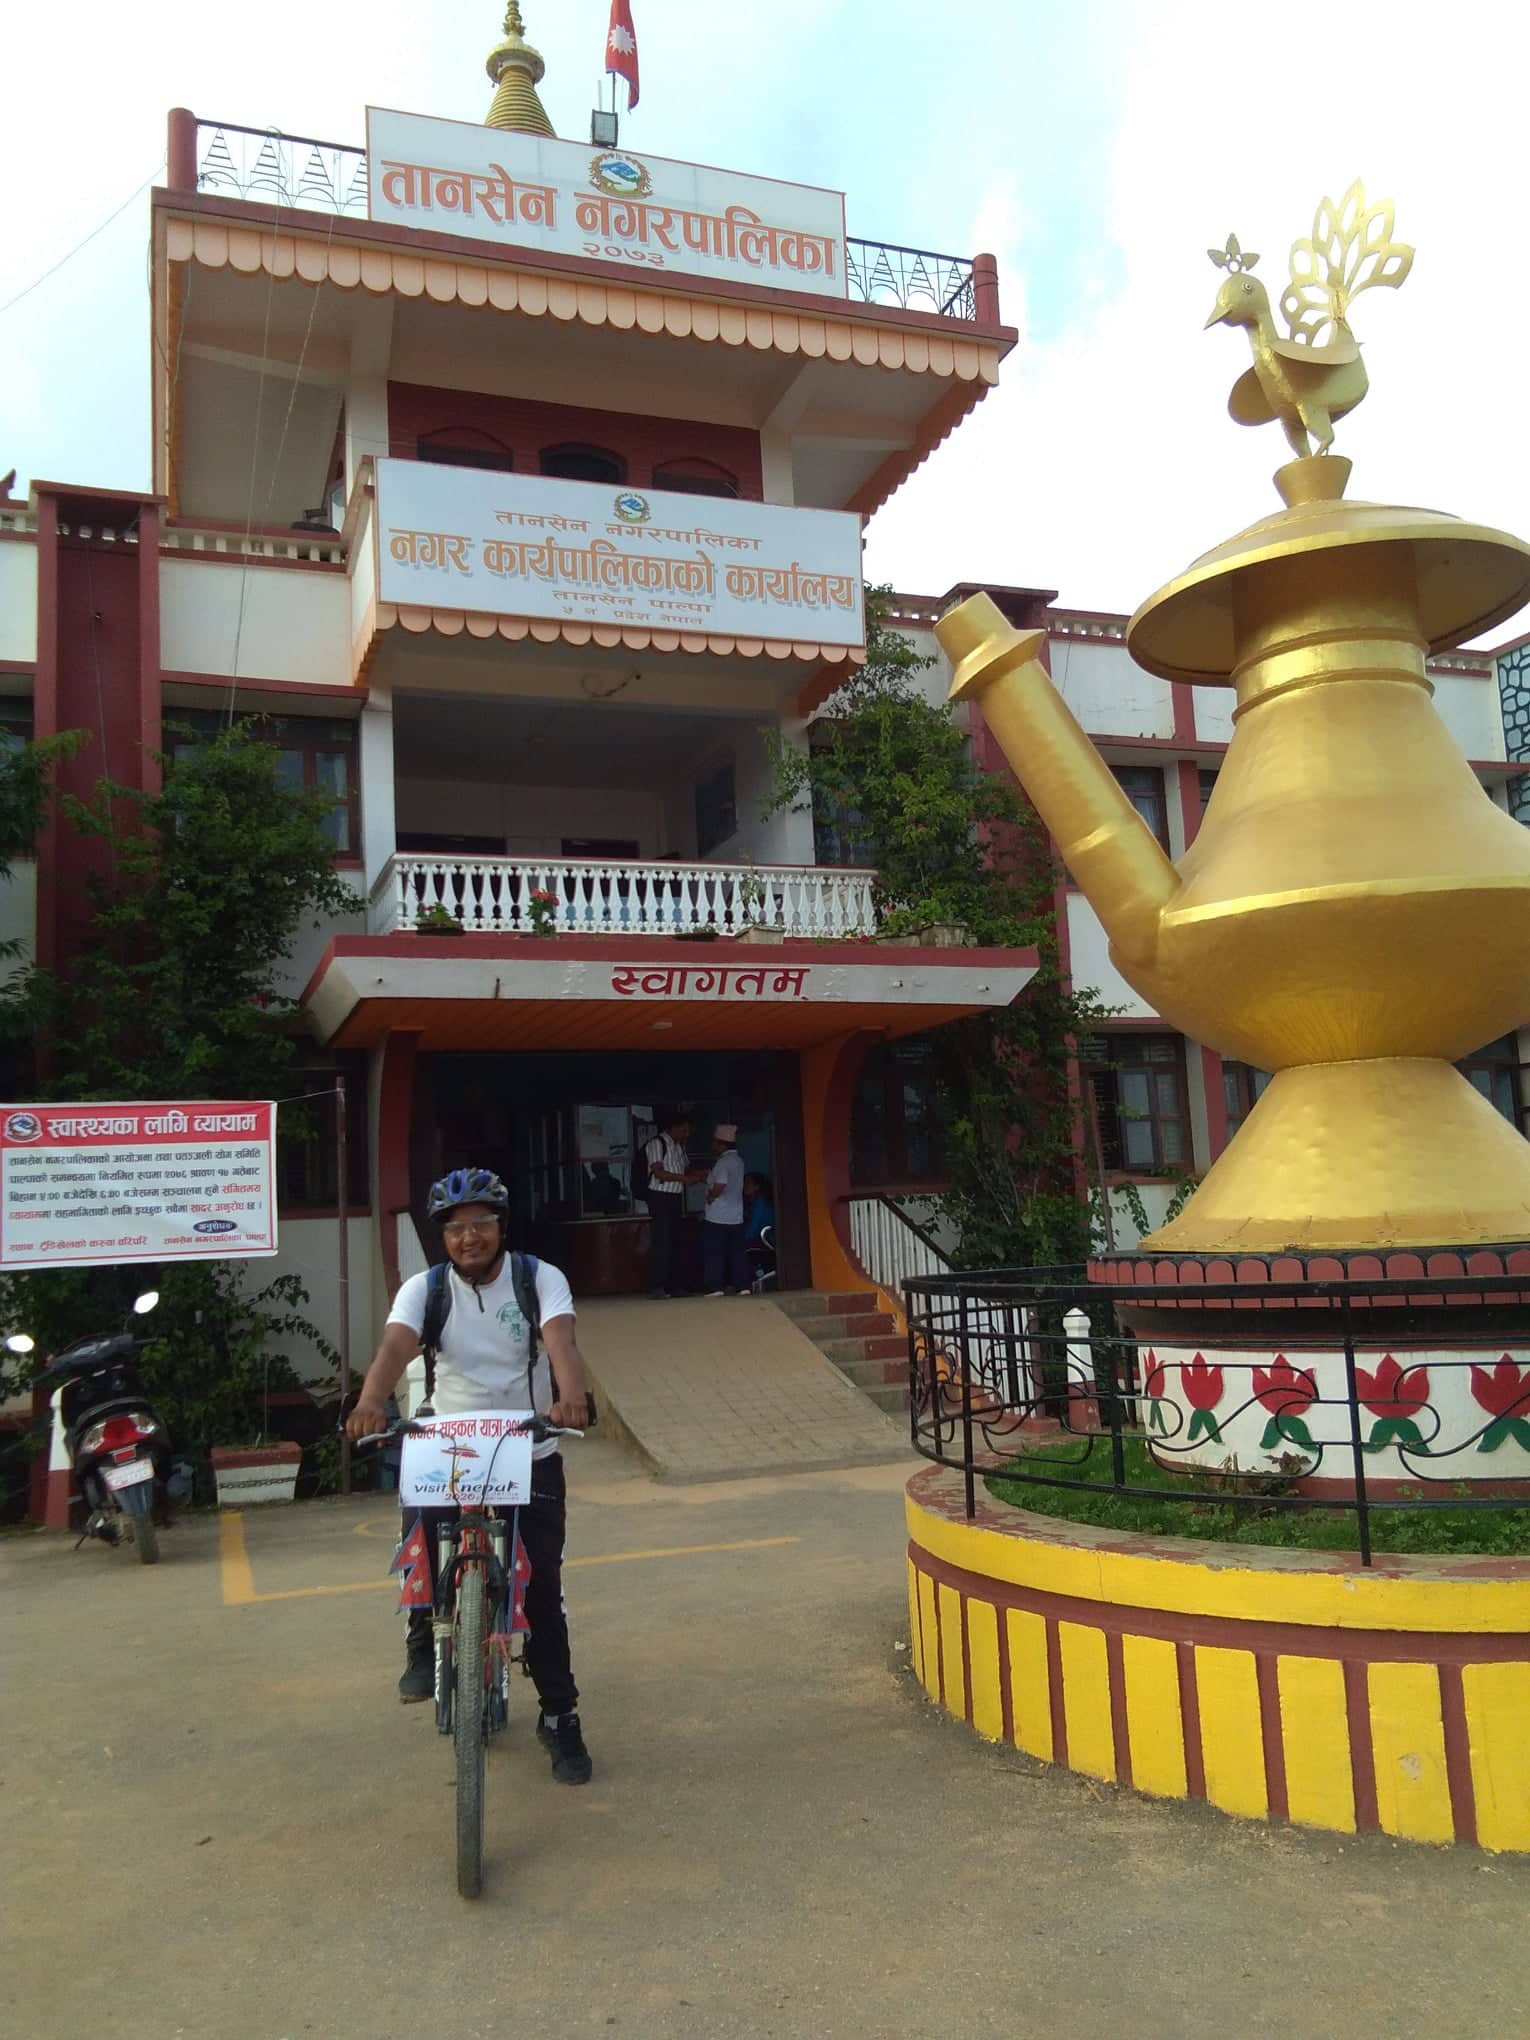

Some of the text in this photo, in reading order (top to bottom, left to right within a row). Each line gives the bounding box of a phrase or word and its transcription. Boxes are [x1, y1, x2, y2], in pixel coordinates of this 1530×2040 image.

[381, 160, 836, 276] तानसेन नगरपालिका
[494, 510, 763, 552] तानसेन नगरपालिका
[388, 527, 856, 608] नगर कार्यपालिकाको कार्यालय
[552, 589, 635, 607] तानसेन
[47, 1110, 257, 1138] स्वास्थ्यका लागि व्यायाम
[414, 1482, 446, 1494] visit
